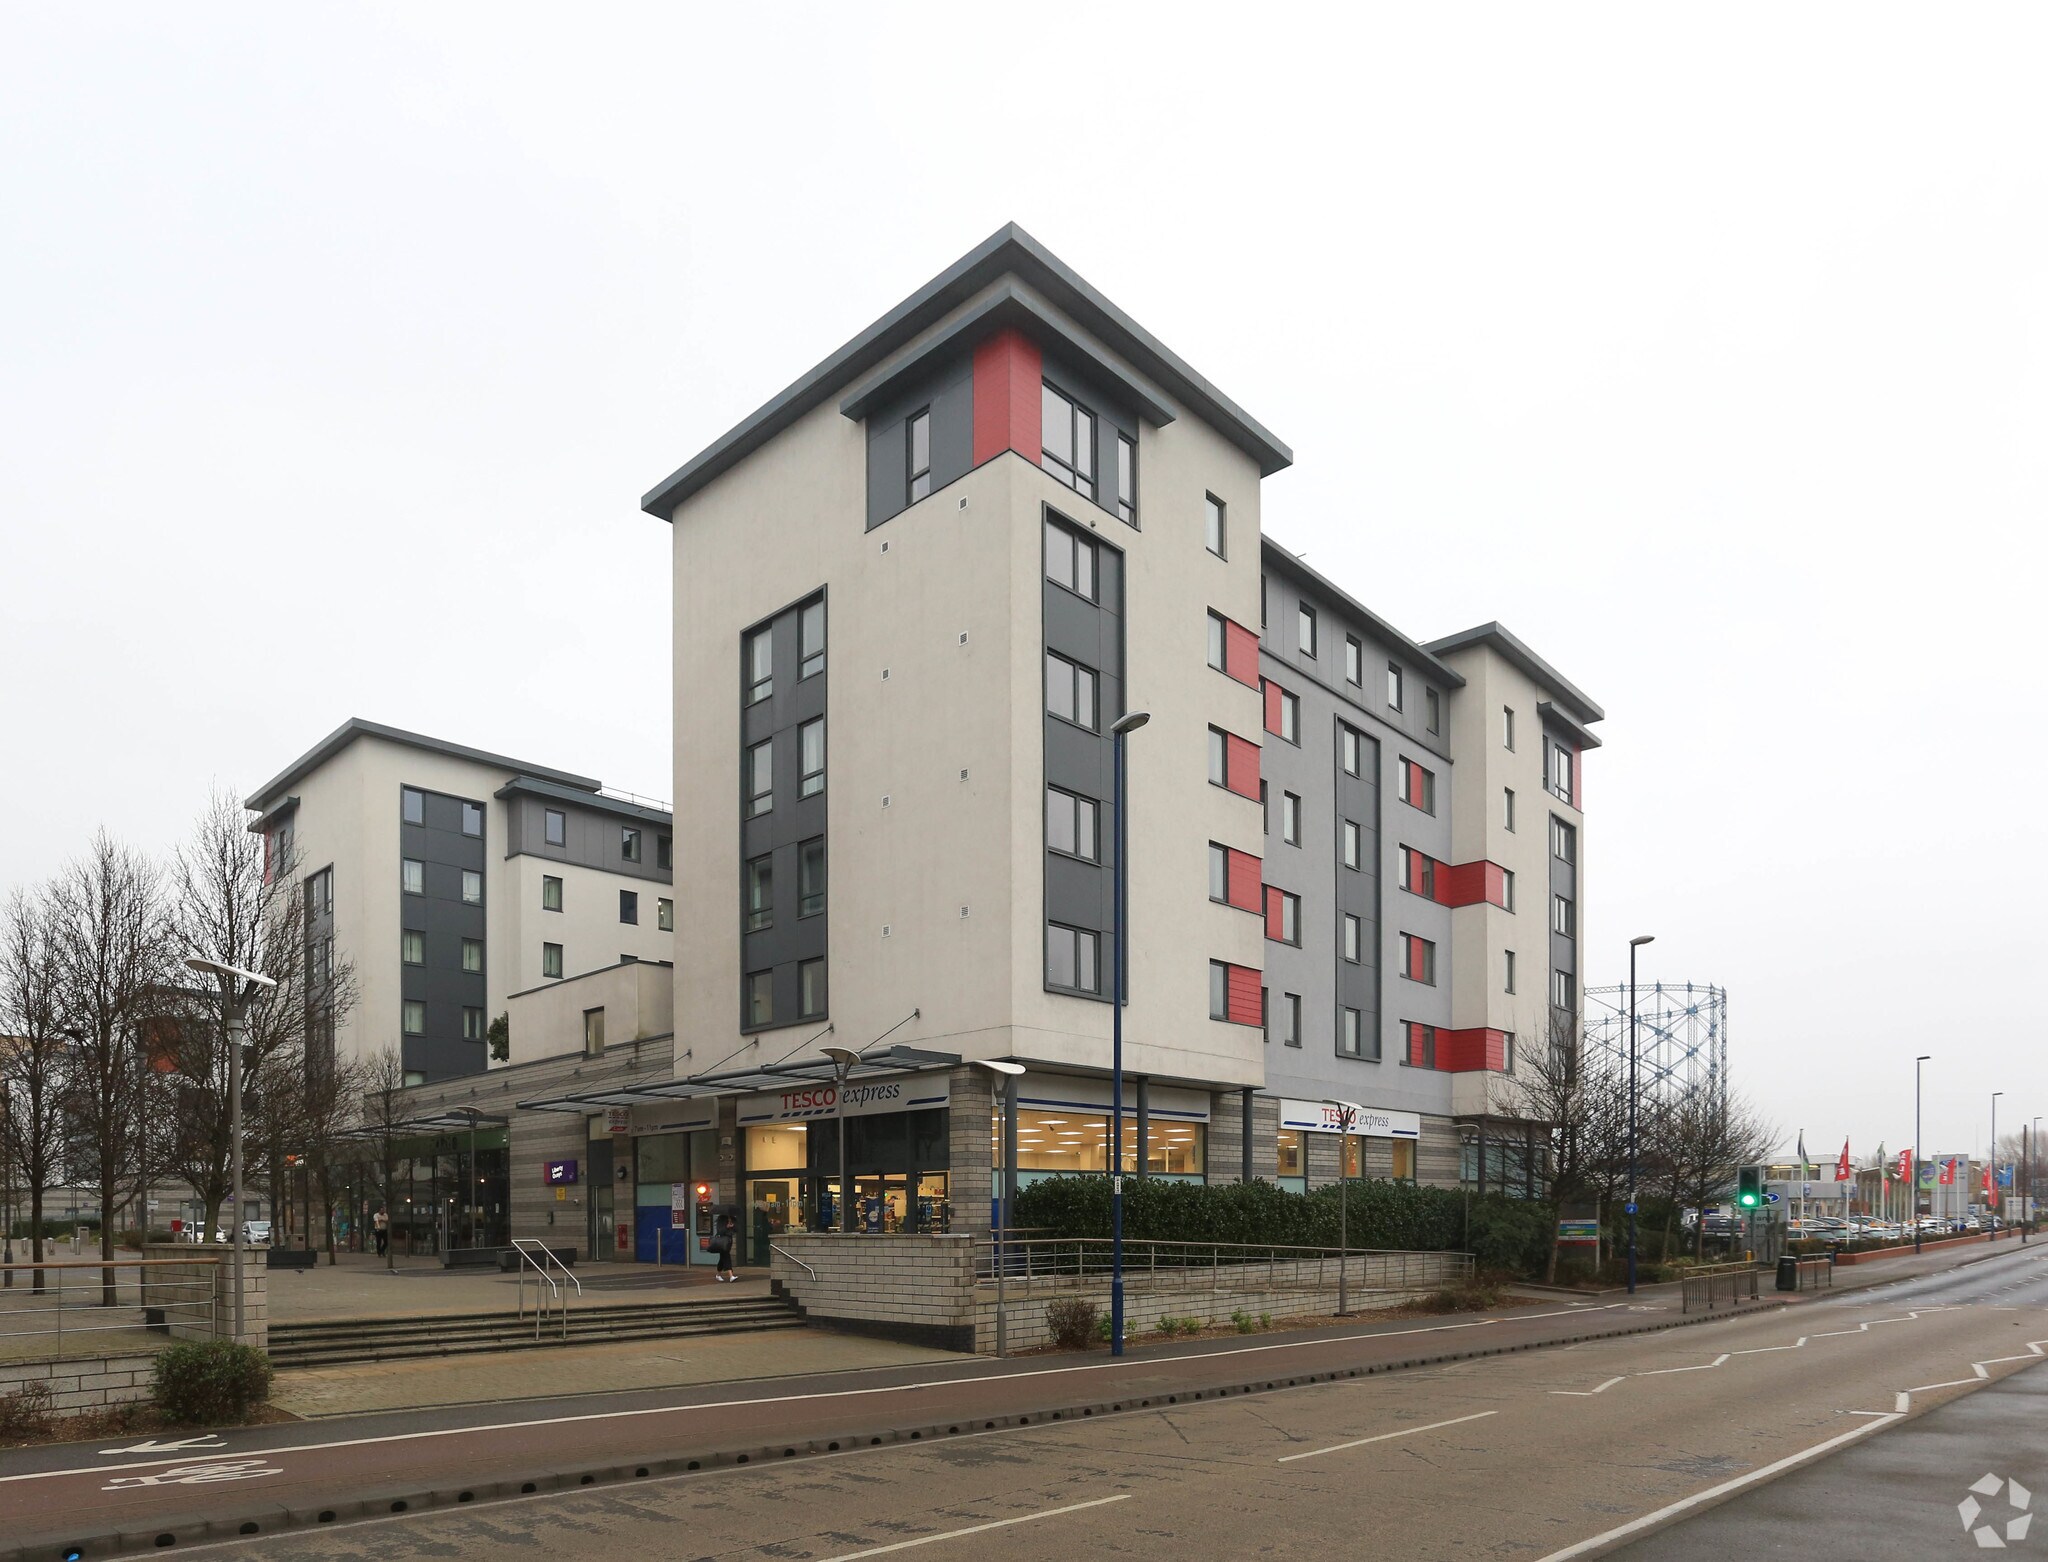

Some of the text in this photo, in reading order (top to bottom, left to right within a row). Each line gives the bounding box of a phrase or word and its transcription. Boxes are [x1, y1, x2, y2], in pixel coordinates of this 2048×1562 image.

[780, 1084, 900, 1109] TESCO express
[1359, 1114, 1389, 1130] express
